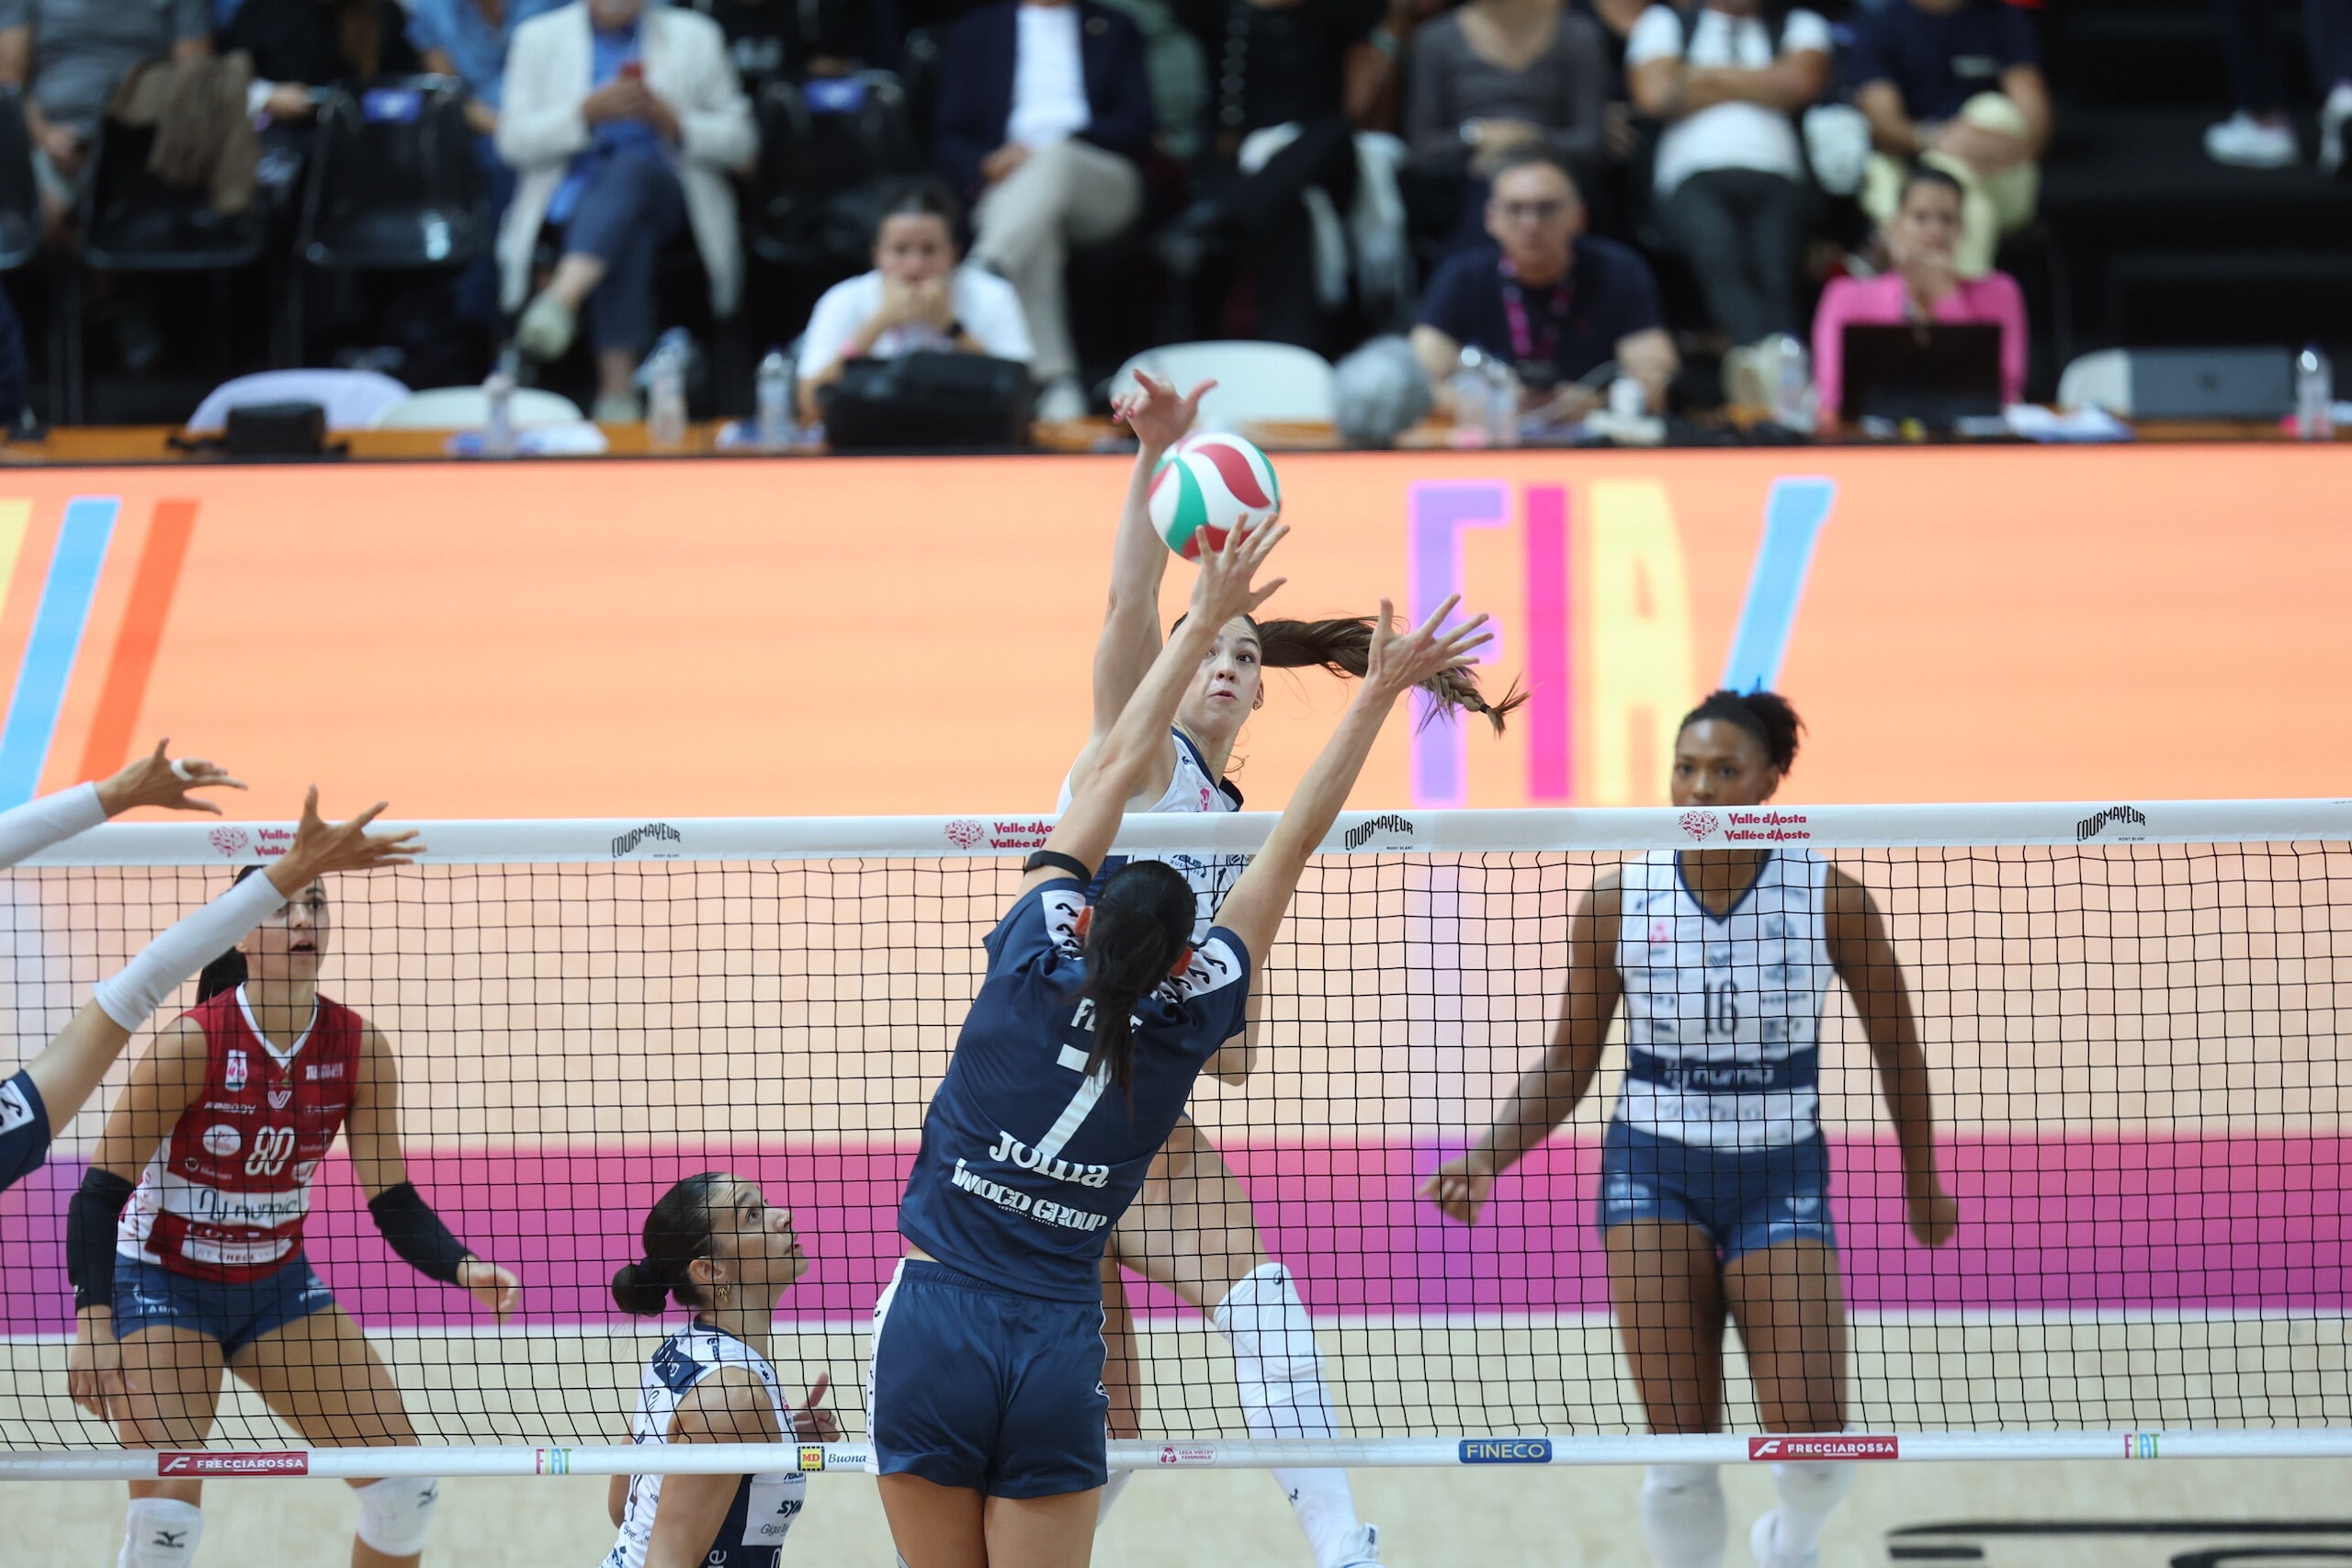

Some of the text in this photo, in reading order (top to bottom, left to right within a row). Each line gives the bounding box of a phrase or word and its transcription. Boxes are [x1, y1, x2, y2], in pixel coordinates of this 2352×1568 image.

[1727, 810, 1807, 826] Valle d'Aosta
[2076, 805, 2145, 841] COURMAYEUR
[257, 829, 291, 840] Valle
[993, 820, 1056, 835] Valle d'Ao
[1345, 814, 1413, 851] COURMAYEUR
[1724, 828, 1811, 842] Vallée d'Aoste
[612, 822, 681, 859] COURMAYEUR
[989, 838, 1031, 851] Vallée
[254, 845, 288, 856] Vallé
[1704, 979, 1738, 1035] 16
[1034, 1043, 1113, 1157] 7
[244, 1125, 296, 1177] 80
[989, 1130, 1110, 1189] Joma
[1032, 1198, 1108, 1232] GROUP
[1466, 1443, 1545, 1459] FINECO
[1787, 1443, 1894, 1453] FRECCIAROSSA
[2124, 1433, 2160, 1460] FIAT
[197, 1459, 304, 1470] FRECCIAROSSA
[536, 1448, 572, 1475] FIAT
[802, 1453, 820, 1462] MD
[828, 1453, 866, 1463] Buona
